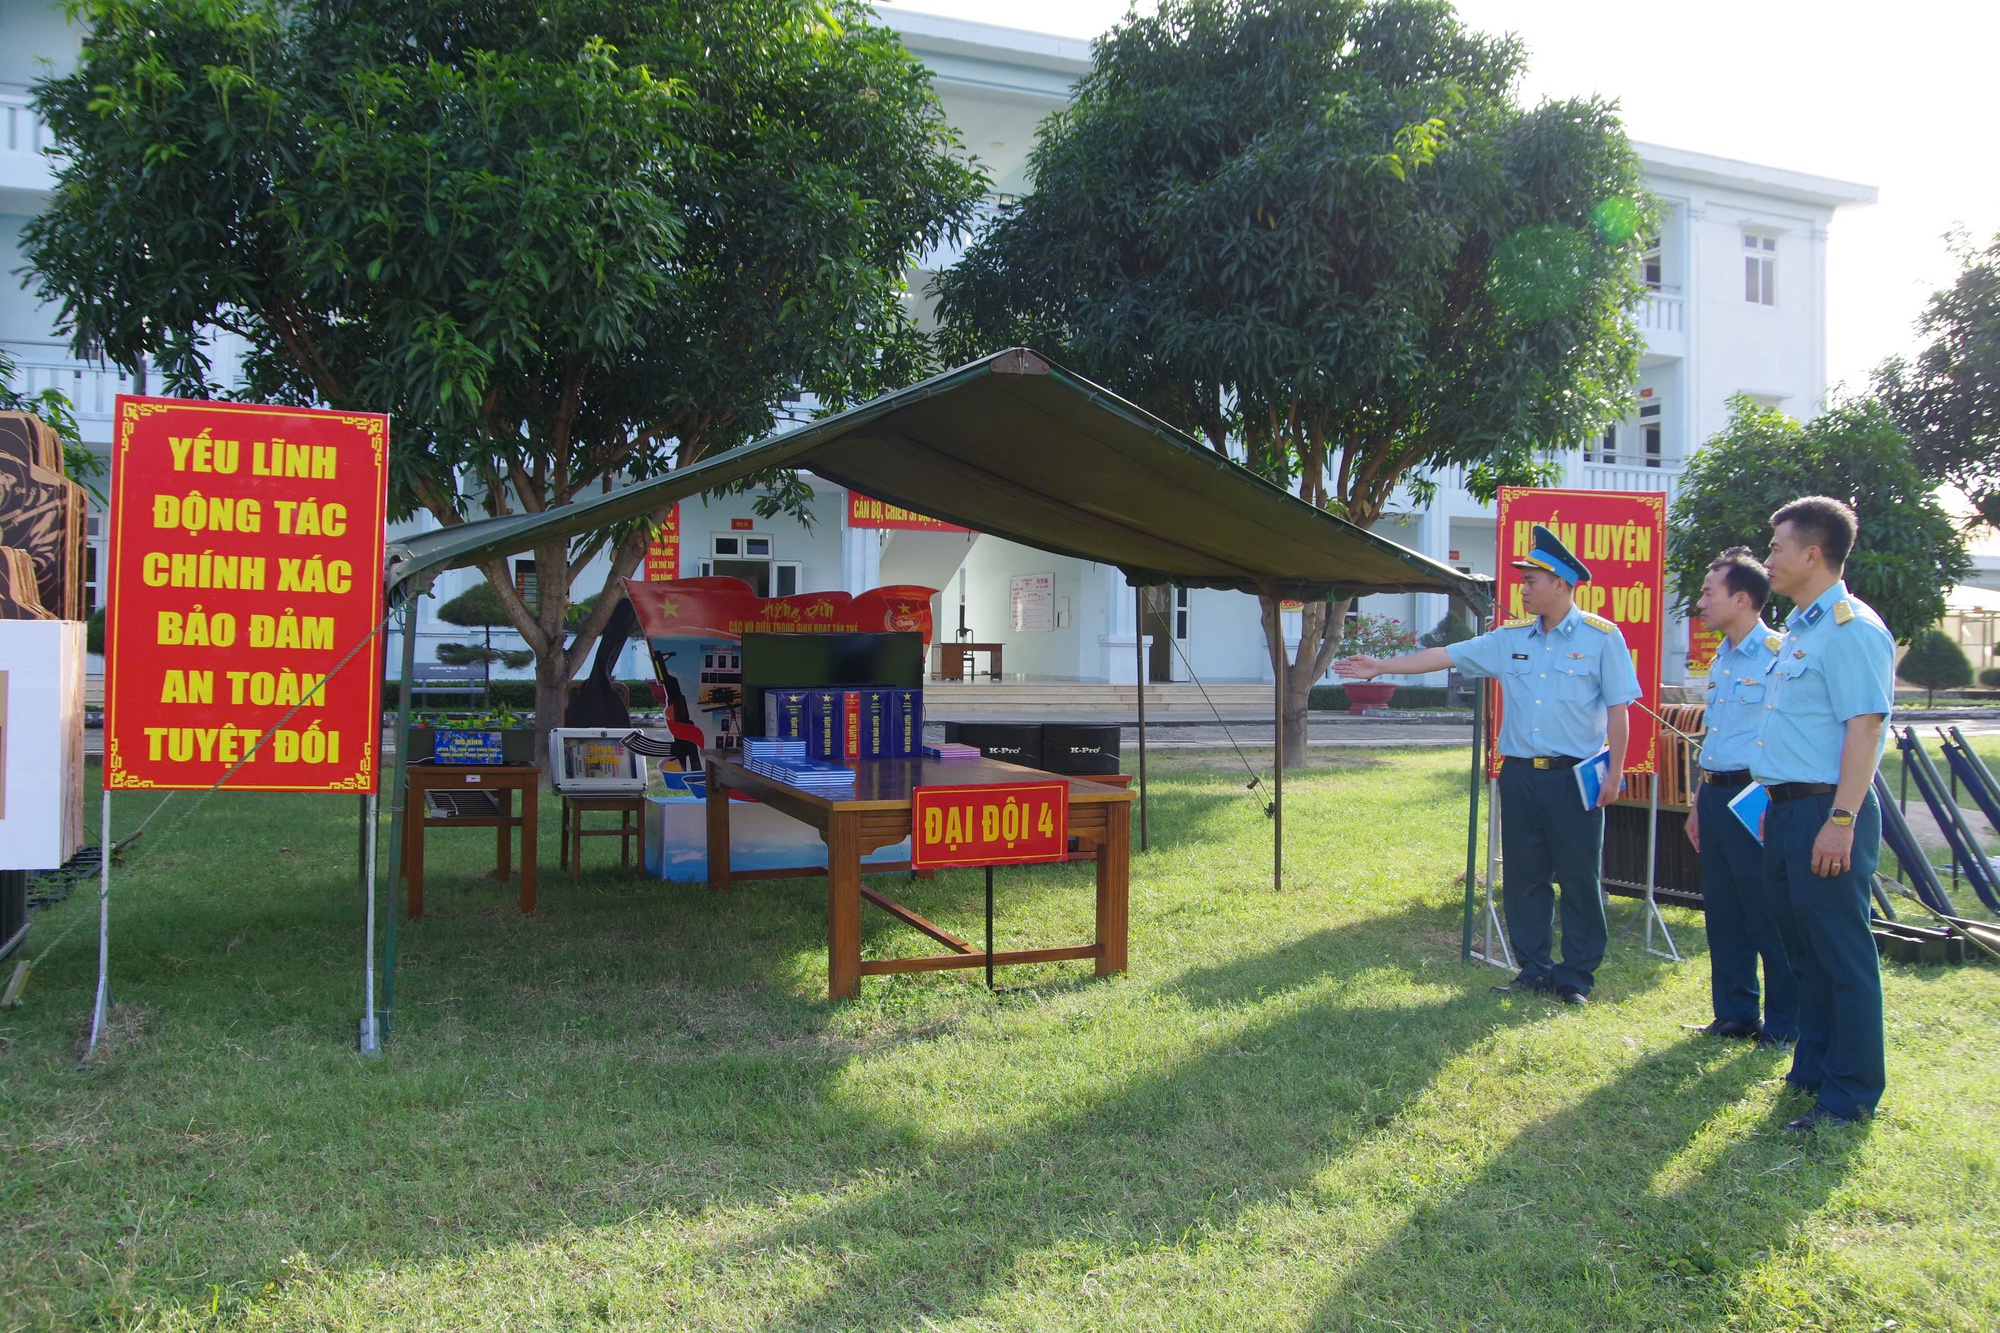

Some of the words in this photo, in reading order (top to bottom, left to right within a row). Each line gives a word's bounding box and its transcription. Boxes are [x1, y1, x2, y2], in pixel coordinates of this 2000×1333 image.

[169, 428, 239, 473] YẾU
[253, 438, 336, 479] LĨNH
[152, 490, 261, 536] ĐỘNG
[274, 497, 346, 536] TÁC
[853, 497, 870, 519] CÁN
[1513, 510, 1577, 557] HẤN
[1584, 520, 1651, 568] LUYỆN
[143, 550, 265, 590] CHÍNH
[277, 555, 352, 594] XÁC
[1573, 580, 1605, 616] ỢP
[1612, 581, 1651, 623] VỚI
[157, 604, 236, 647] BẢO
[249, 608, 335, 650] ĐẢM
[161, 670, 213, 705] AN
[227, 668, 325, 706] TOÀN
[144, 723, 262, 768] TUYỆT
[273, 720, 339, 763] ĐỐI
[1070, 746, 1100, 754] K-Pro
[925, 805, 973, 851] ĐẠI
[982, 796, 1030, 849] ĐỘI
[1037, 803, 1054, 838] 4
